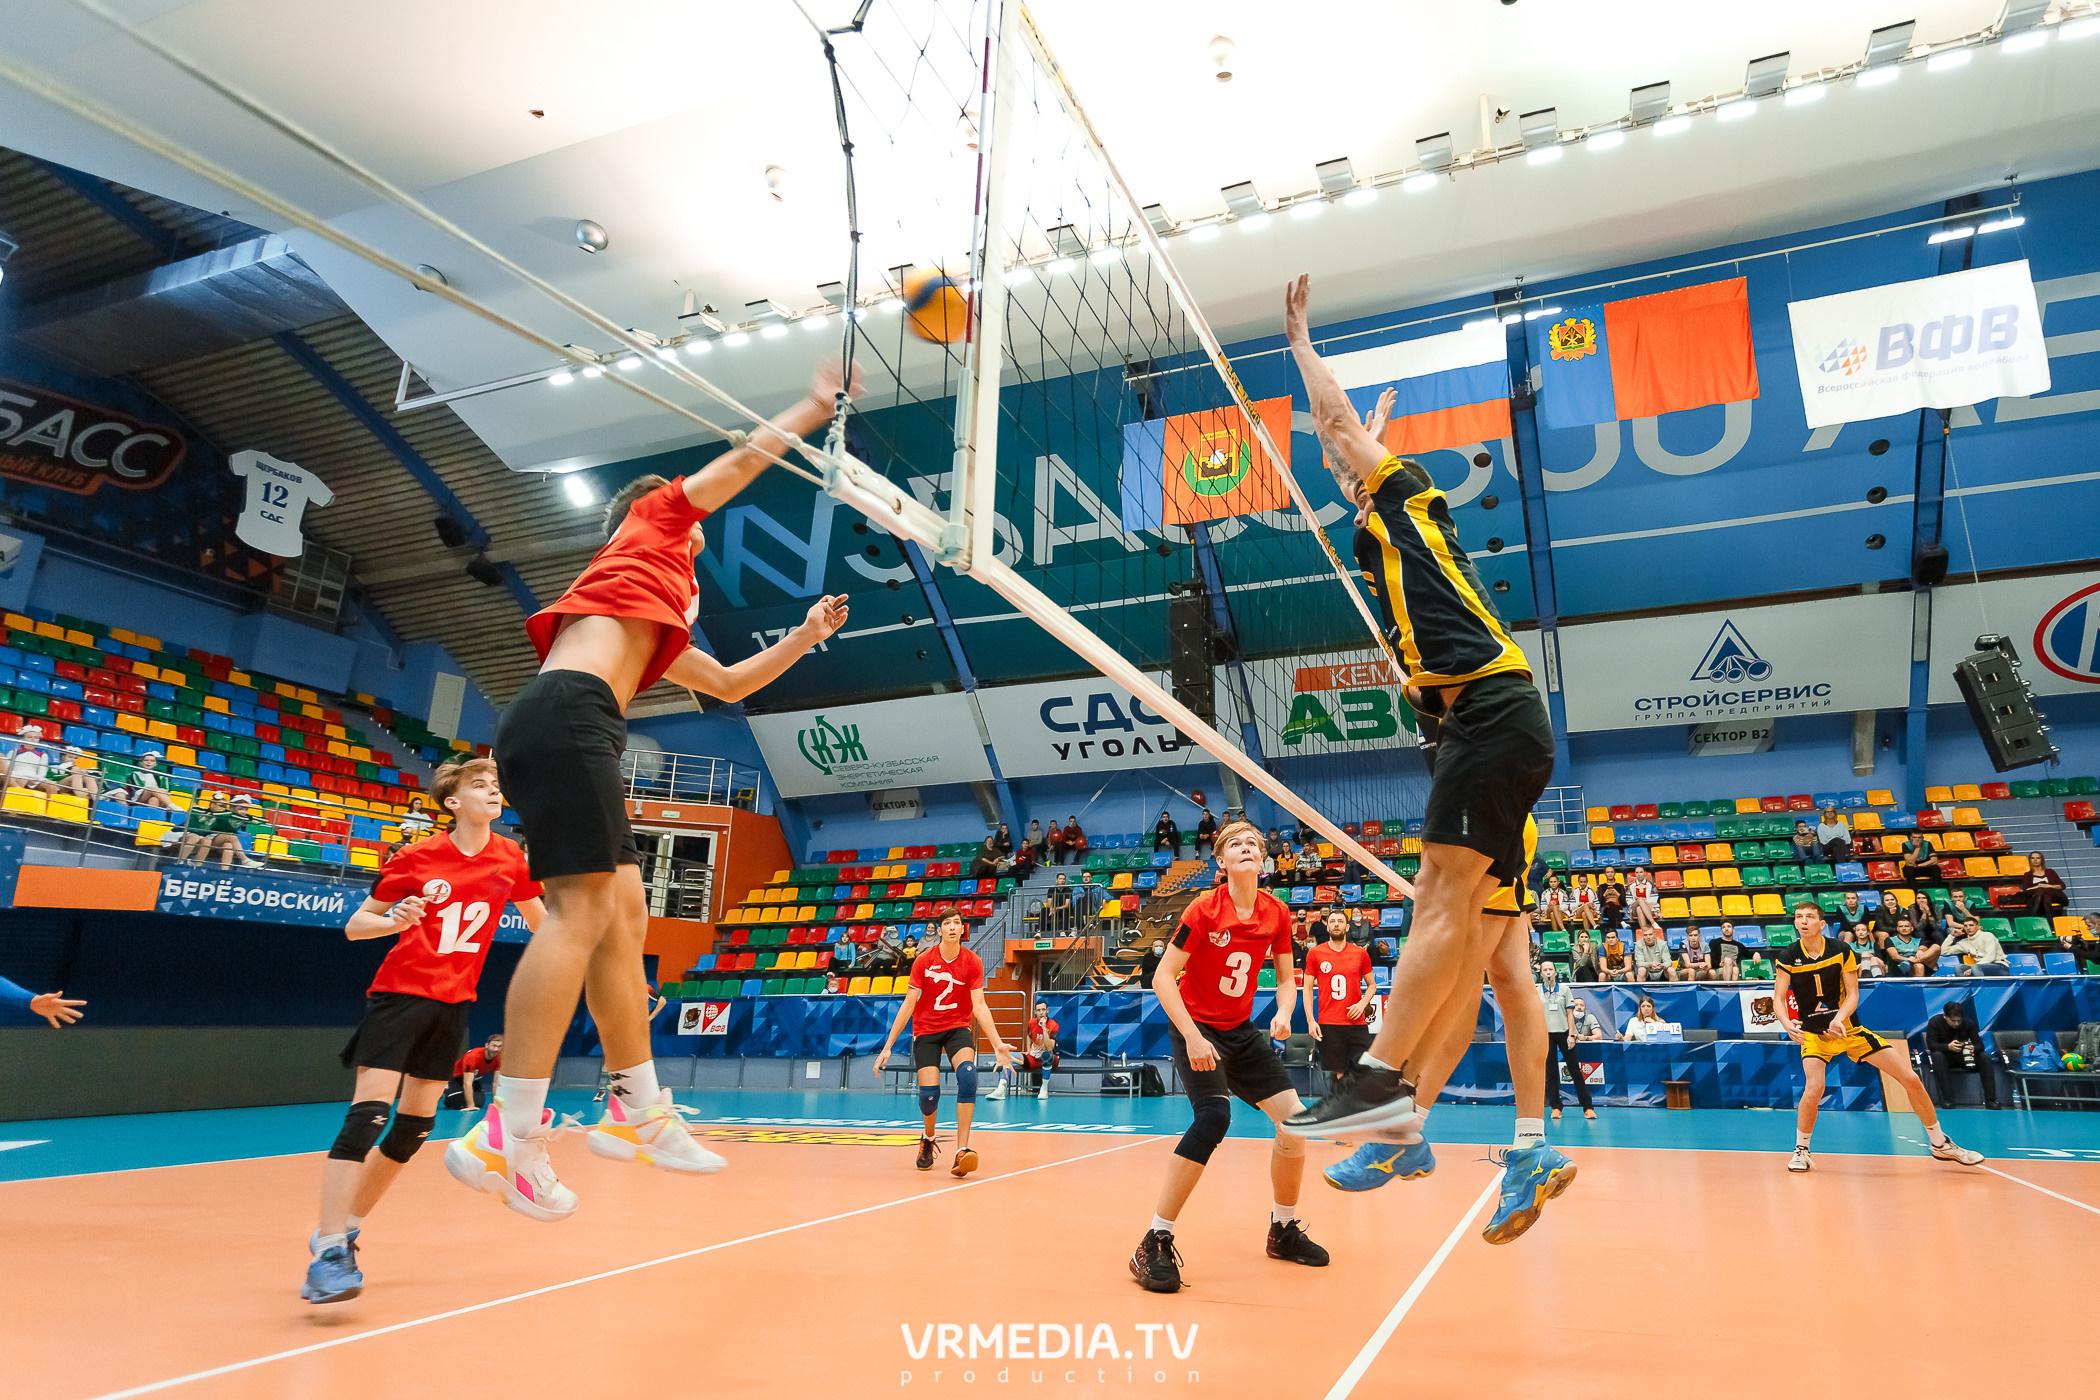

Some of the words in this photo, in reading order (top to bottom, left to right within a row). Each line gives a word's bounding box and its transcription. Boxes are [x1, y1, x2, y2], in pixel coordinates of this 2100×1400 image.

[1876, 304, 2019, 371] ВФВ
[1818, 375, 1898, 394] Всероссийская
[1901, 366, 1964, 381] федерация
[1968, 353, 2030, 372] волейбола
[256, 460, 303, 484] ЩЕРБАКОВ
[261, 481, 289, 508] 12
[1634, 682, 1832, 711] СТРОЙСЕРВИС
[1635, 711, 1696, 721] ГРУППА
[1706, 699, 1831, 716] ПРЕДПРИЯТИЙ
[1051, 735, 1180, 760] УГОЛЬ
[1694, 730, 1747, 743] СЕКТОР
[832, 755, 940, 773] СЕВЕРО-КУЗБАССКАЯ
[836, 766, 924, 781] ЭНЕРГЕТИЧЕСКАЯ
[840, 778, 894, 788] КОМПАНИЯ
[872, 800, 906, 811] СЕКТОР
[164, 878, 344, 914] БЕРЁЗОВСКИЙ
[436, 901, 491, 954] 12
[1218, 951, 1252, 998] 3
[1813, 973, 1824, 997] 1
[1330, 974, 1347, 1000] 9
[1671, 1024, 1680, 1034] 14
